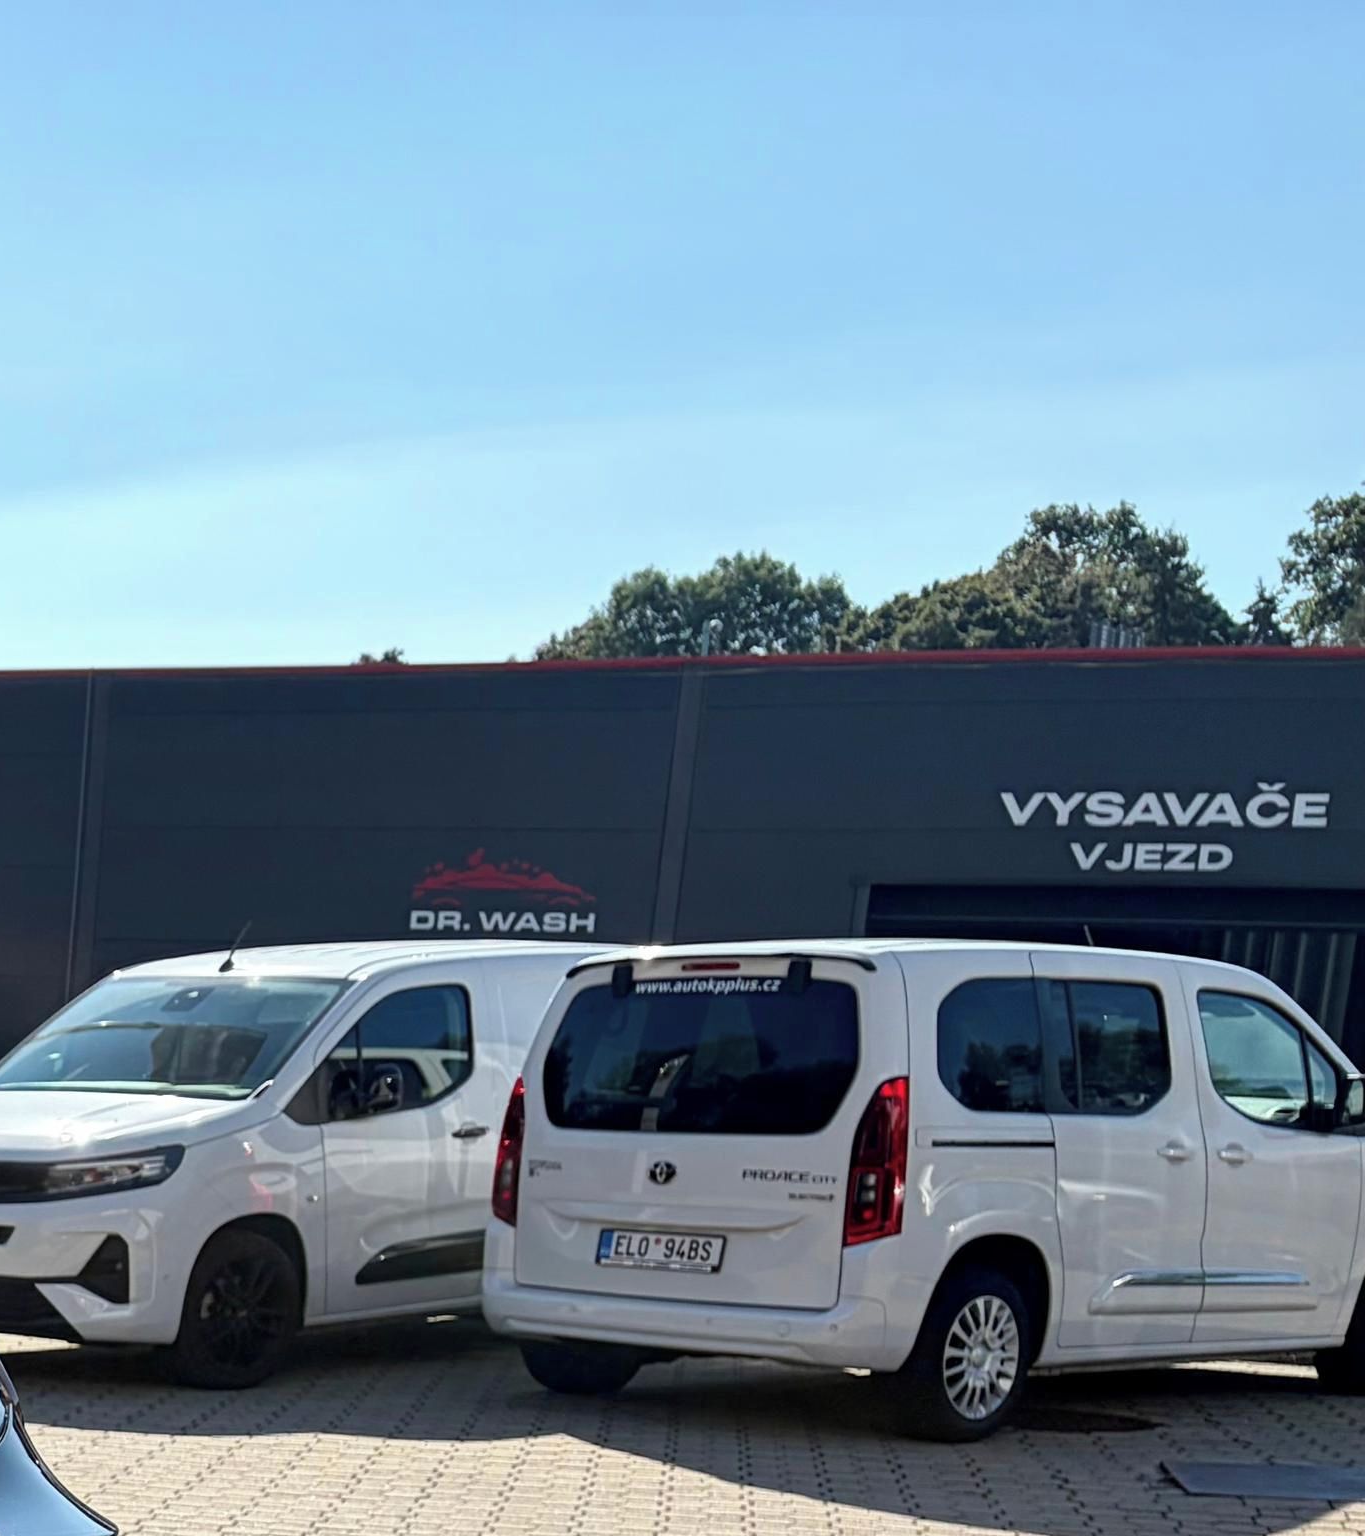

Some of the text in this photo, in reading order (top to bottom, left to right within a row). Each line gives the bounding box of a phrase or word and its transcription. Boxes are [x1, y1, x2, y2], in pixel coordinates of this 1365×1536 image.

[1000, 782, 1331, 828] VYSAVAČE
[1070, 842, 1234, 872] VJEZD
[409, 909, 597, 933] DR. WASH
[635, 977, 782, 995] www.autokpplus.cz
[742, 1169, 810, 1184] PROACE
[663, 1239, 713, 1262] 94BS
